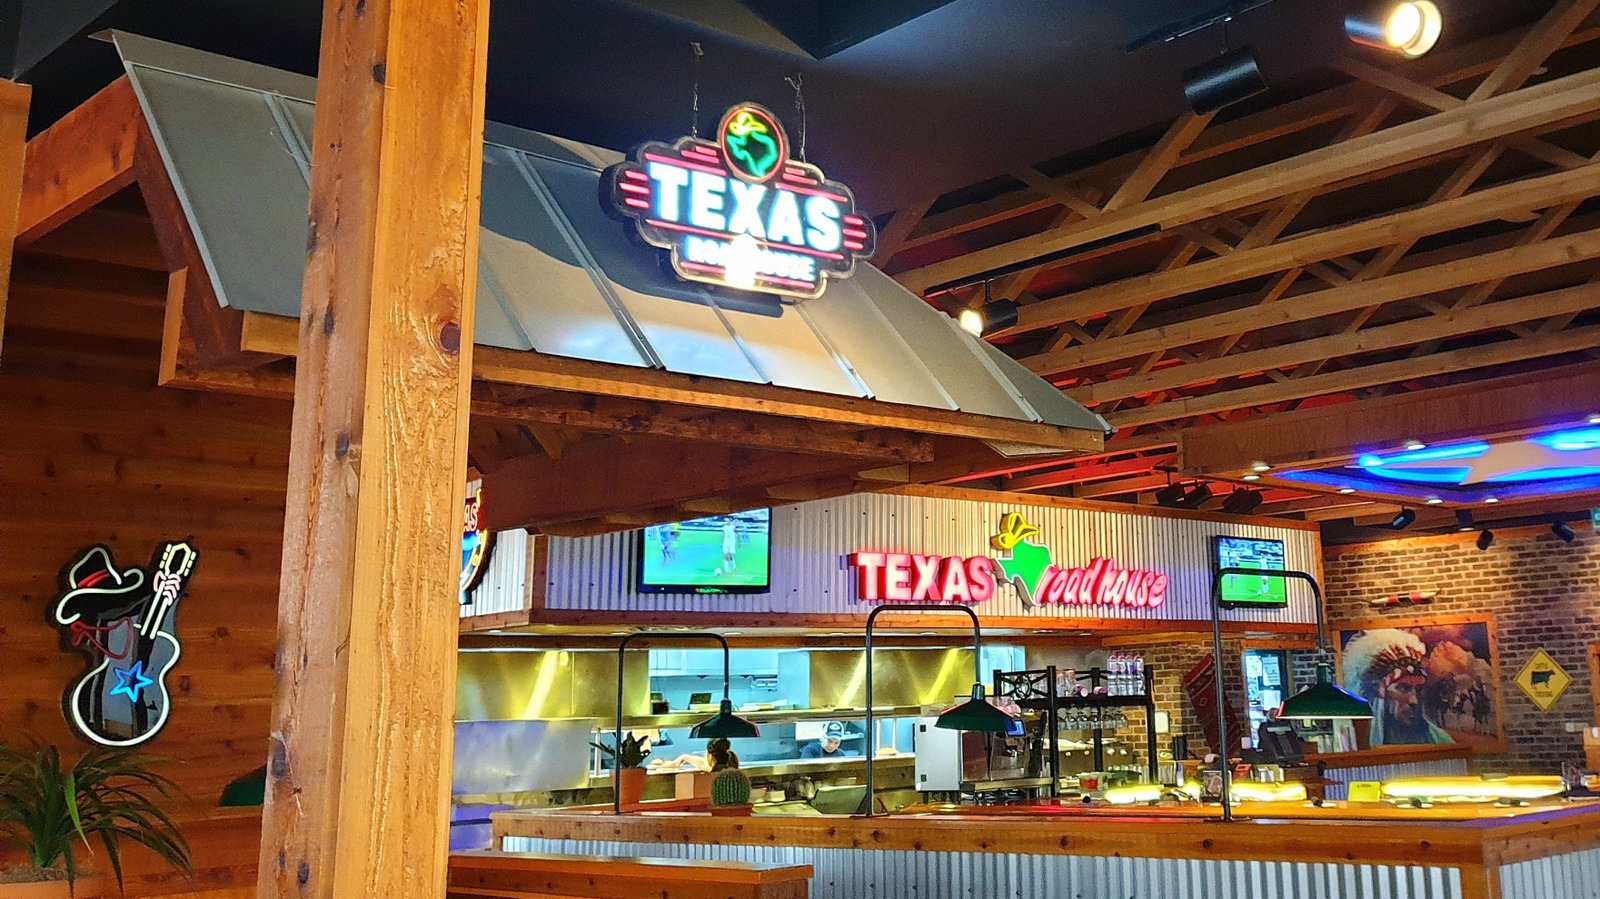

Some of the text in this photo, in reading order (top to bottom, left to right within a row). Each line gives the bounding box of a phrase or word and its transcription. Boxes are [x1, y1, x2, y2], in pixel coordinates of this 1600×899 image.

[648, 160, 842, 252] TEXAS
[687, 235, 816, 282] ROAOUSE
[856, 551, 995, 602] TEXAS
